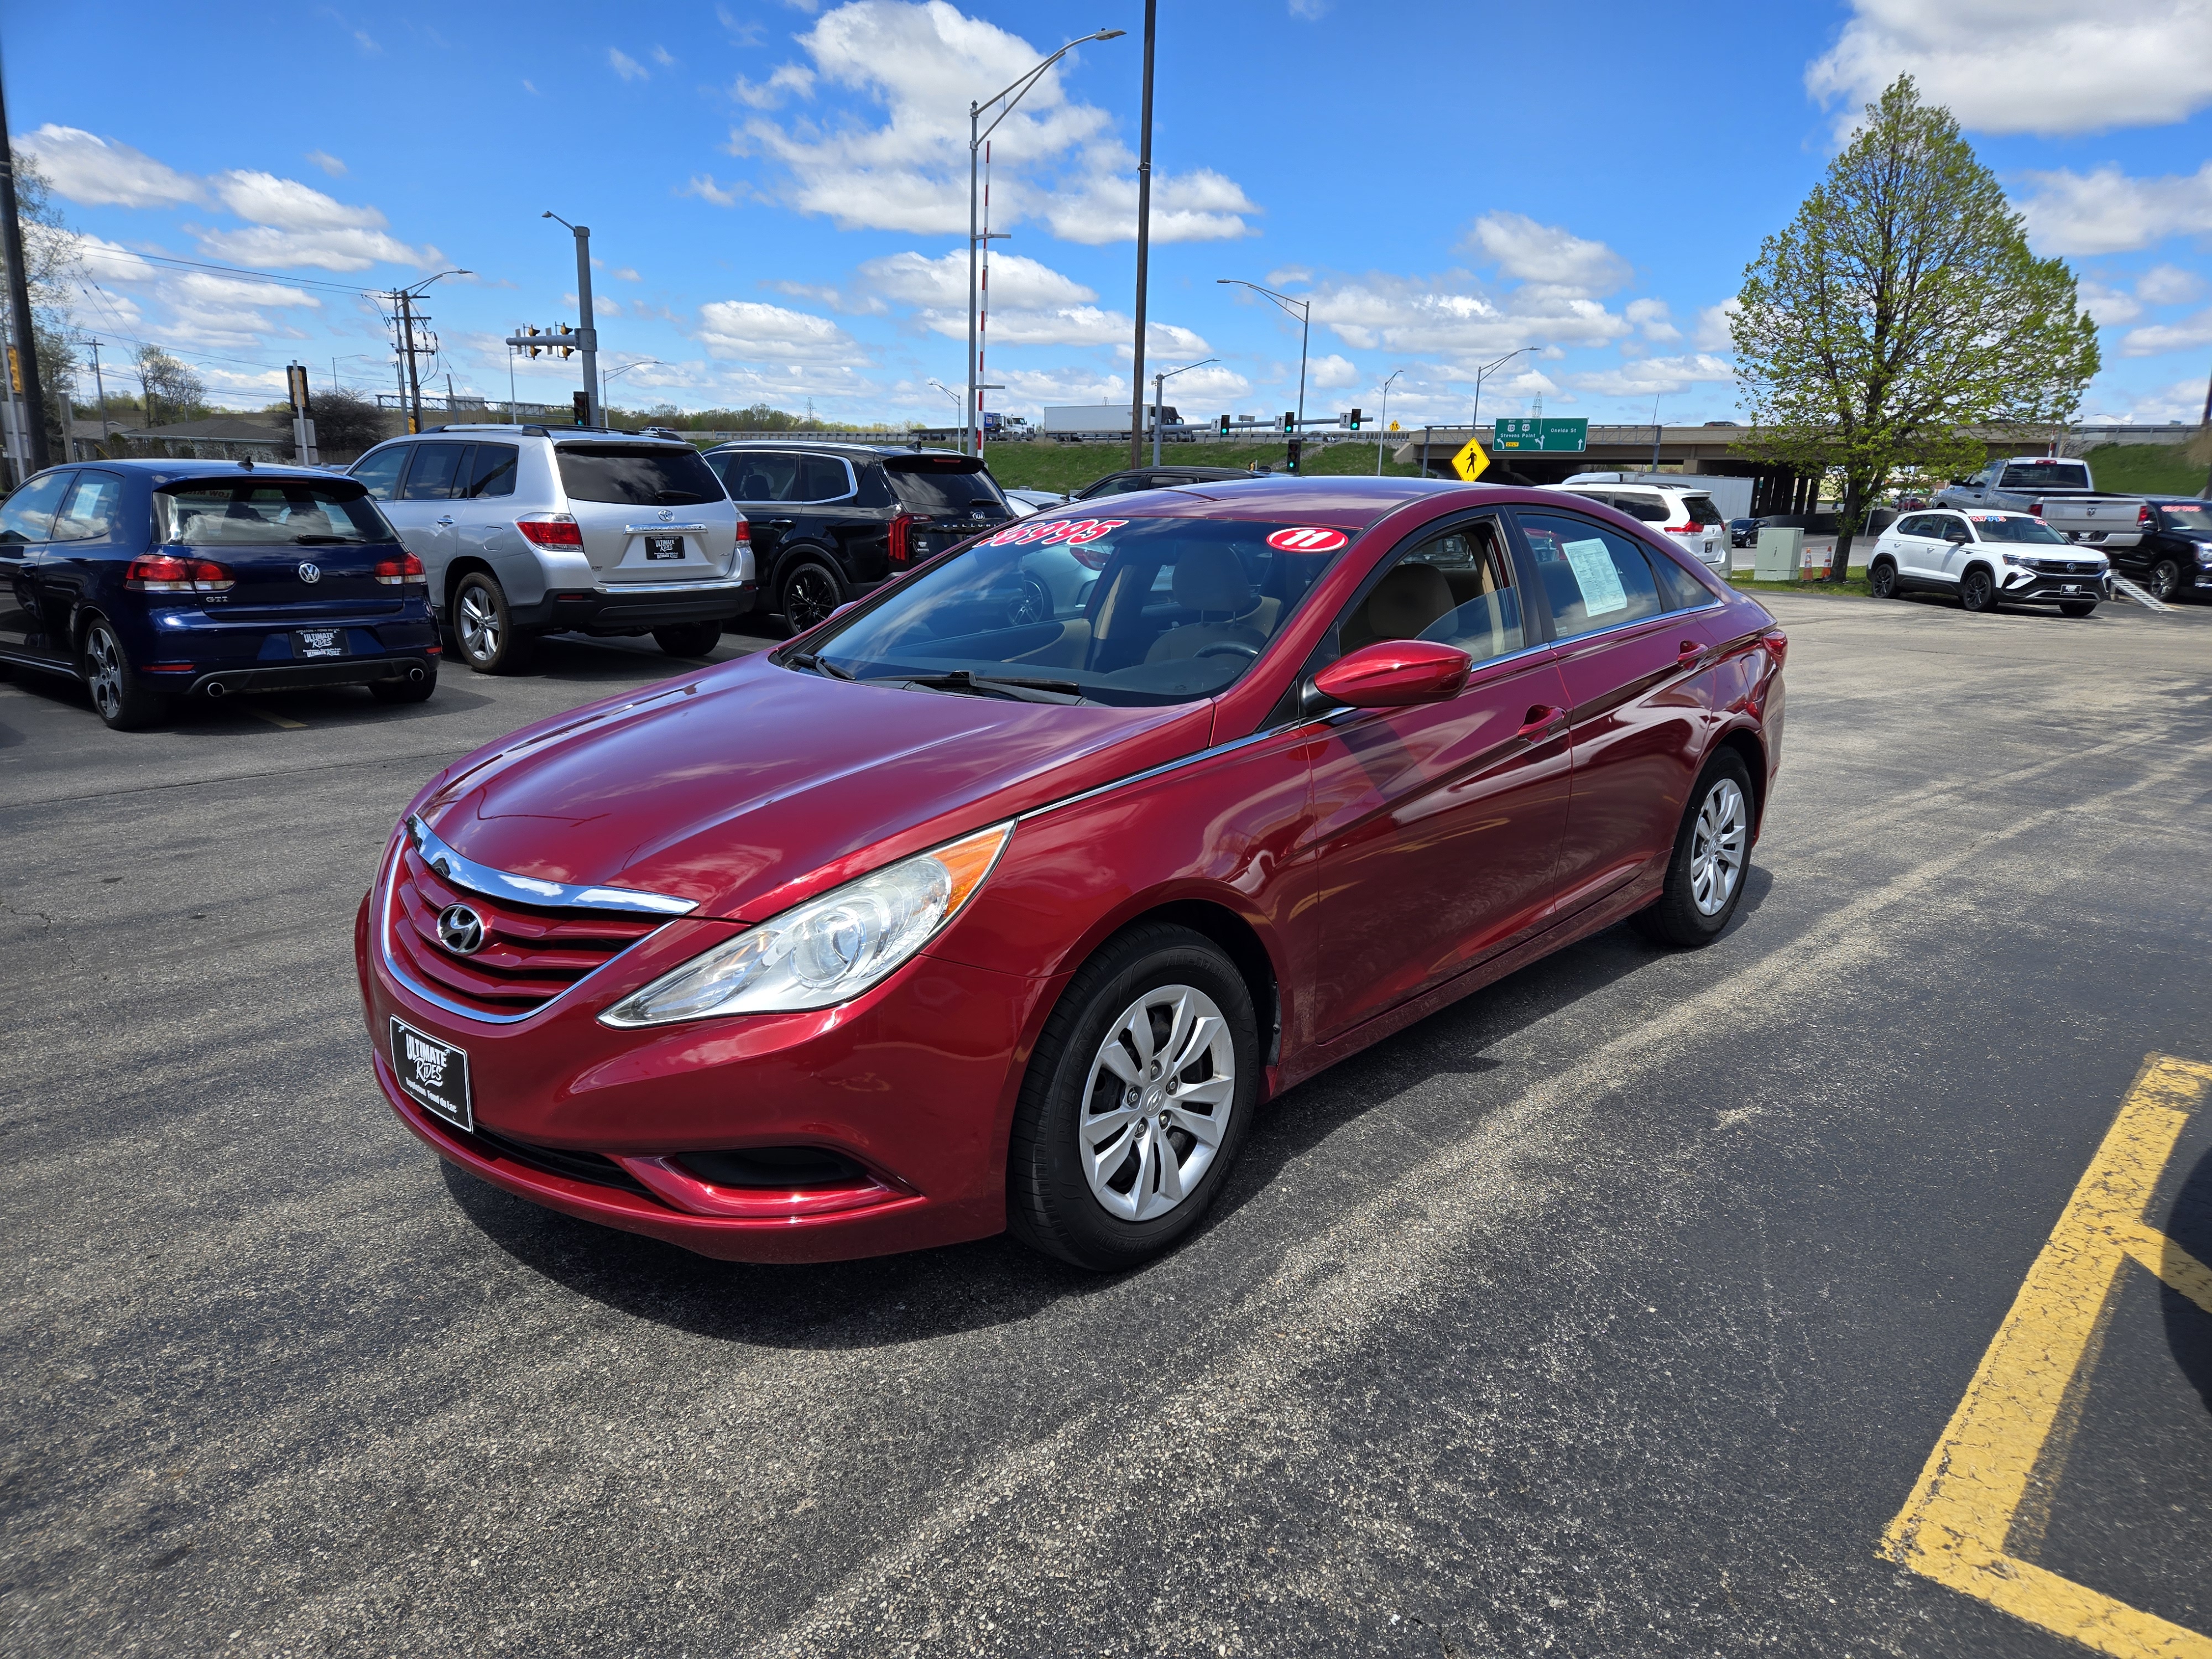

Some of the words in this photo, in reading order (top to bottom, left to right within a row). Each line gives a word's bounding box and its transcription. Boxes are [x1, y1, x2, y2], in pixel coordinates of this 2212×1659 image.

[1281, 529, 1333, 547] 11
[304, 633, 335, 643] ULTIMATE
[312, 638, 332, 648] RIDES
[405, 1033, 447, 1068] ULTIMATE
[405, 1077, 426, 1097] Appleton
[427, 1089, 440, 1104] Fond
[440, 1097, 447, 1108] du
[447, 1100, 457, 1113] Lac
